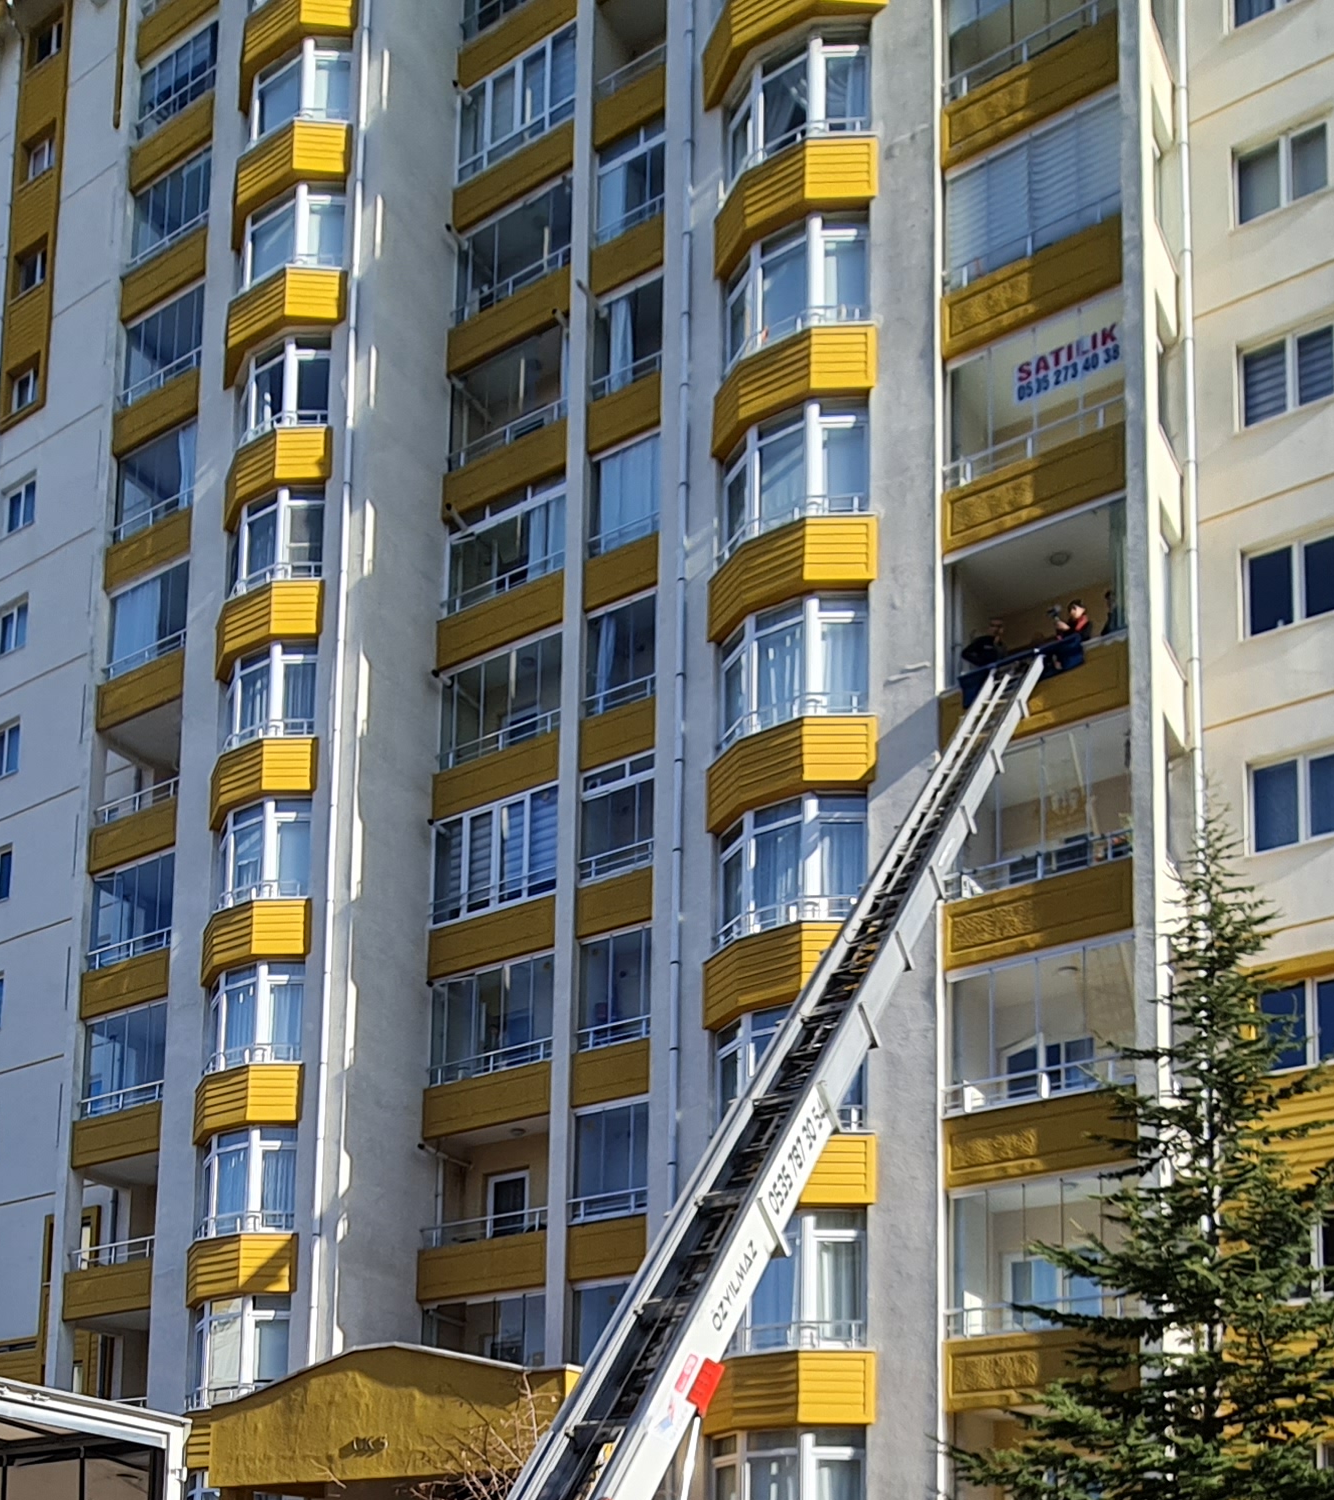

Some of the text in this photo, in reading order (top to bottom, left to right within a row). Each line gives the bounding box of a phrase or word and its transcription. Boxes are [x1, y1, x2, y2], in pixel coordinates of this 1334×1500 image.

[1018, 322, 1118, 382] SATILIK
[1054, 361, 1078, 385] 273
[1082, 352, 1099, 371] 40
[768, 1164, 793, 1215] 0535
[787, 1136, 806, 1178] 787
[802, 1117, 817, 1151] 30
[710, 1239, 758, 1331] ÖZYILMAZ
